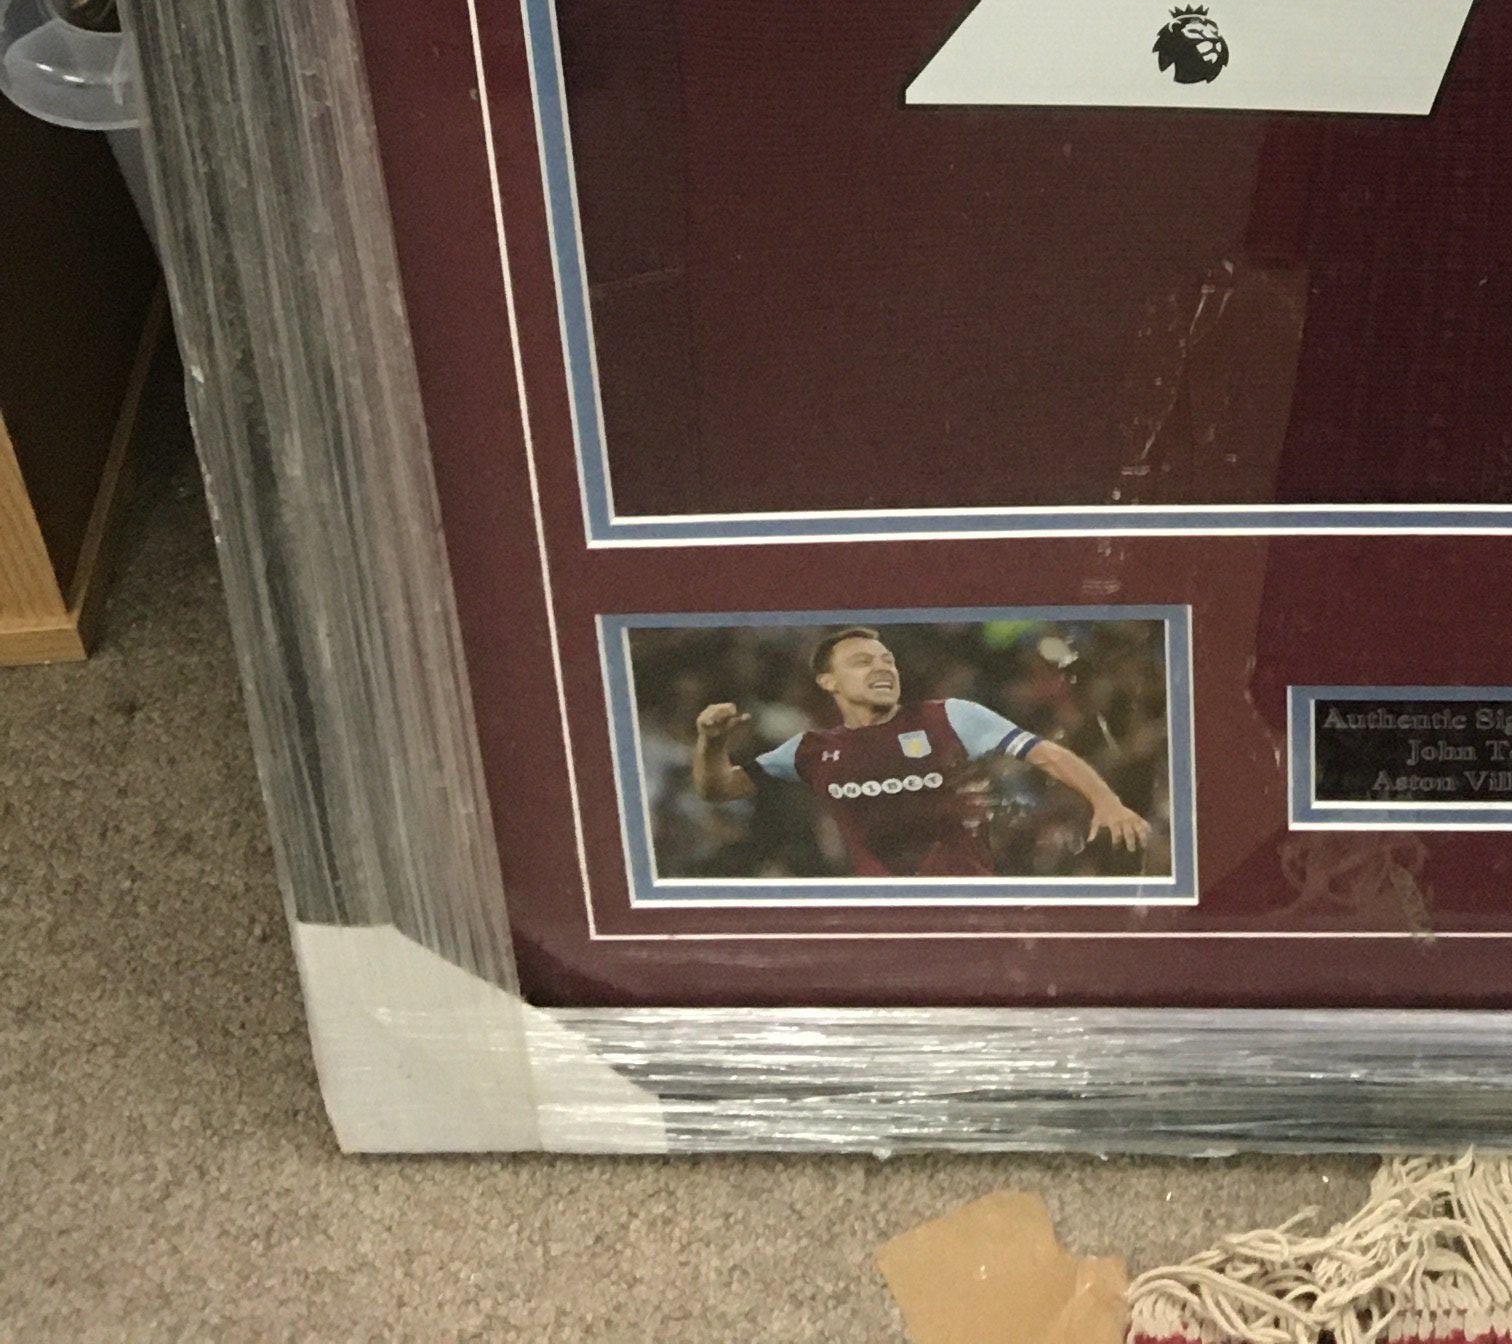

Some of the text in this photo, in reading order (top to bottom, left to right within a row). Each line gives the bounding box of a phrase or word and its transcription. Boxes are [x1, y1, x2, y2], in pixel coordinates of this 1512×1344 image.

[1322, 708, 1467, 731] Authentic
[1407, 739, 1477, 765] John
[1372, 770, 1457, 793] Aston
